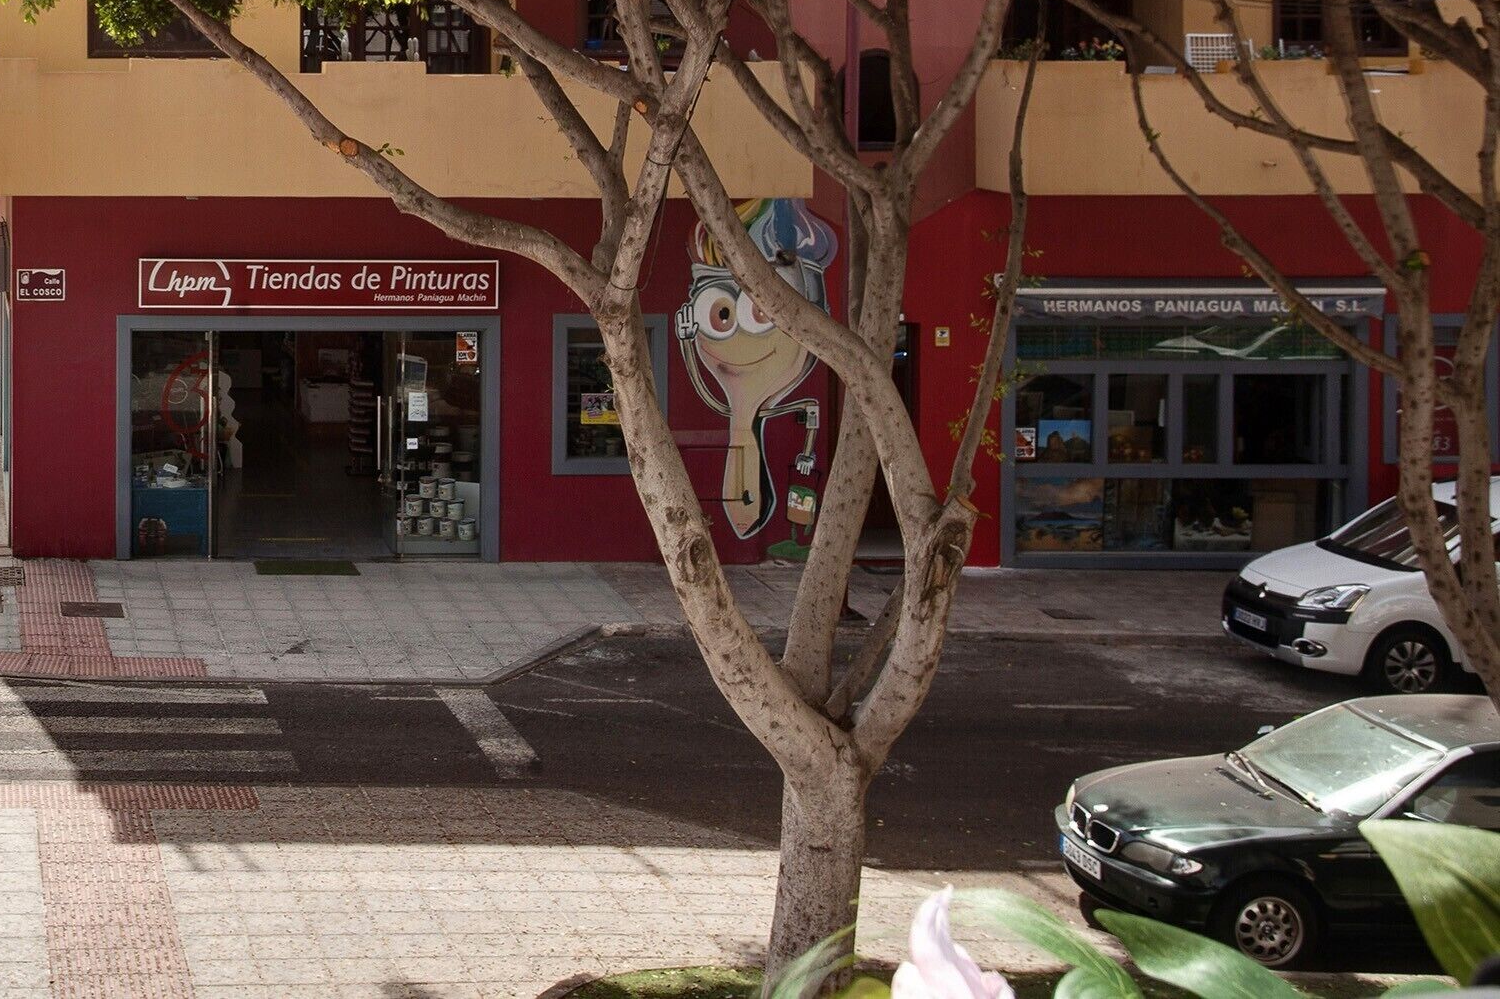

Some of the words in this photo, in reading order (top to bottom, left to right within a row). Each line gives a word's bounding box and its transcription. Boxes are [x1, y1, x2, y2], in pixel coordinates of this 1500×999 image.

[246, 265, 342, 290] Tiendas
[350, 265, 382, 290] de
[390, 265, 490, 290] Pinturas
[20, 288, 30, 296] EL
[33, 288, 62, 296] COSCO
[373, 293, 415, 302] Hermanos
[417, 293, 455, 304] Paniagua
[457, 293, 487, 302] Machín
[1043, 300, 1142, 313] HERMANOS
[1154, 300, 1244, 313] PANIAGUA
[1335, 300, 1367, 313] S.L.
